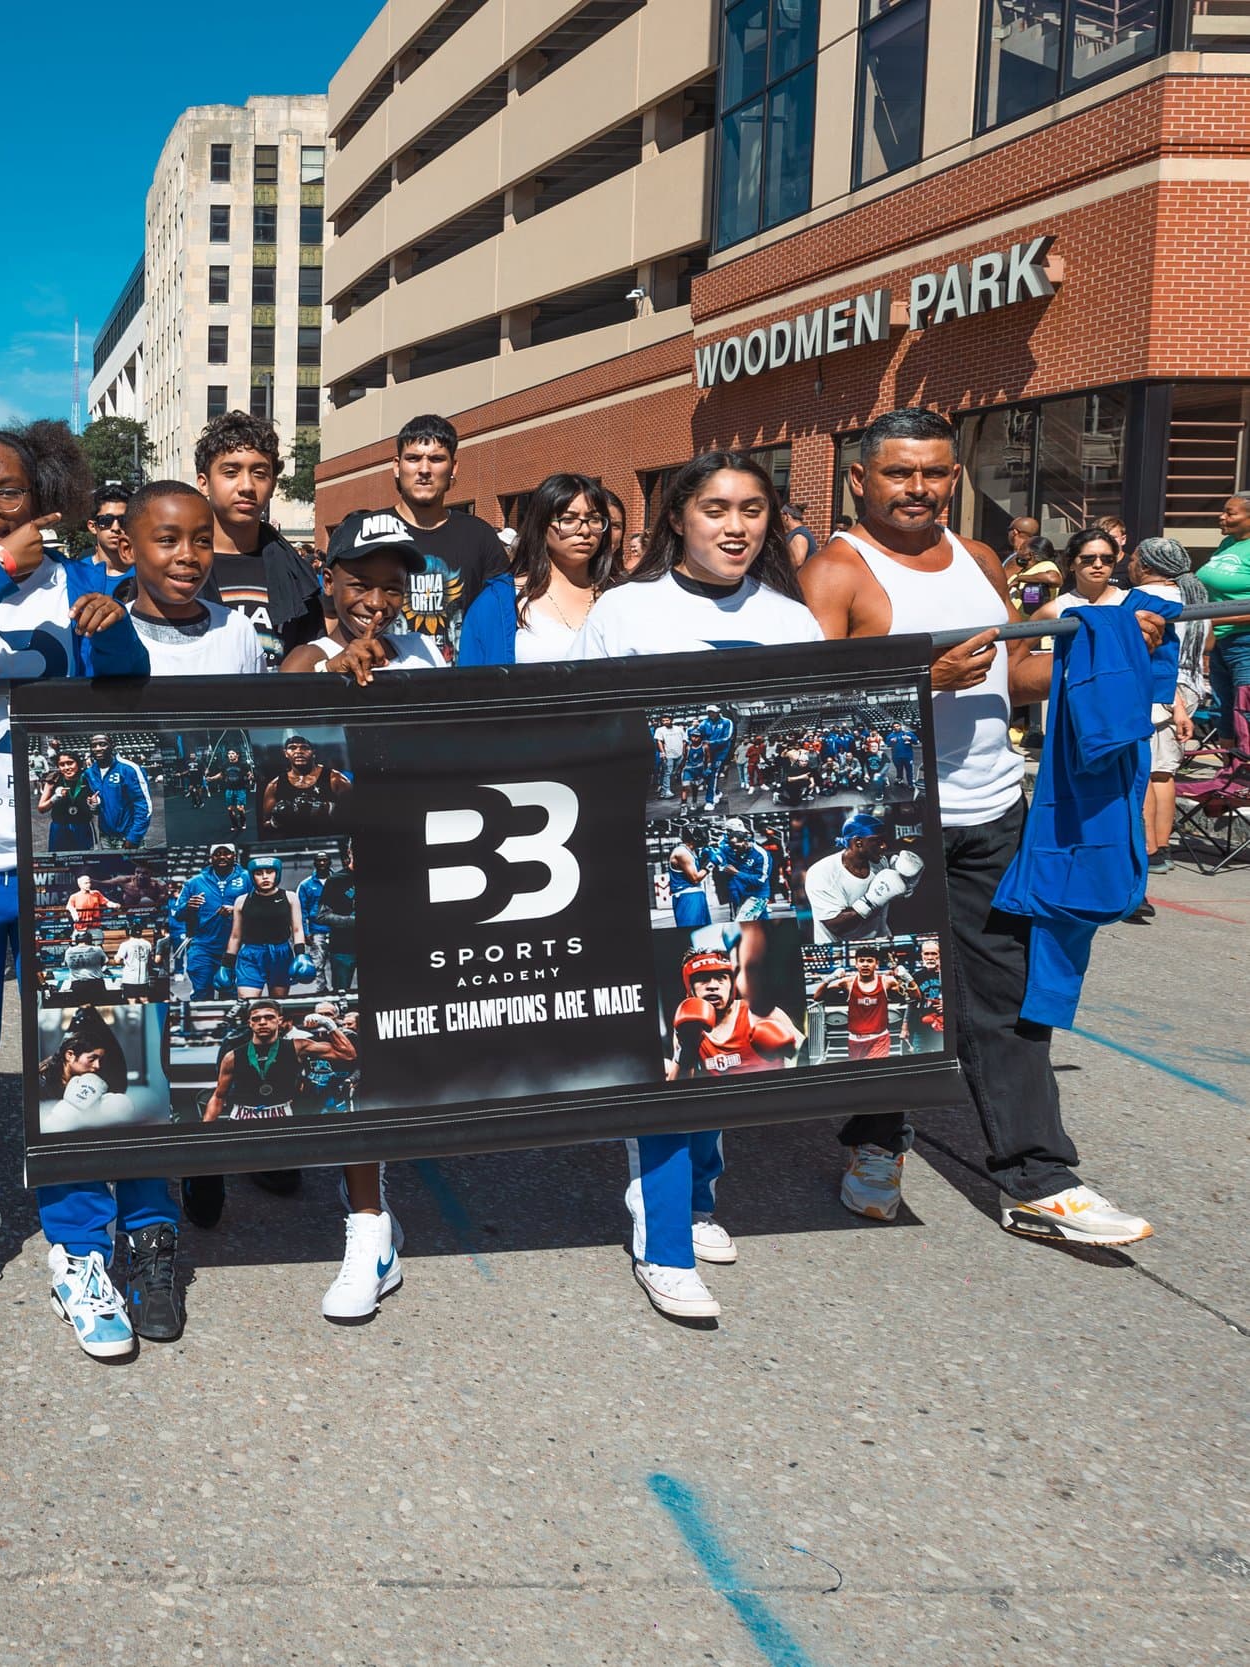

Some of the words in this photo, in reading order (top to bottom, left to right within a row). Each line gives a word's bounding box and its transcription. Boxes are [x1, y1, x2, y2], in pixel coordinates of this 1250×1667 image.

[695, 288, 892, 389] WOODMEN
[910, 235, 1056, 331] PARK
[362, 514, 408, 538] NIKE
[411, 592, 445, 611] ORTIZ
[429, 937, 584, 969] SPORTS
[456, 967, 560, 988] ACADEMY
[375, 1005, 440, 1040] WHERE
[445, 993, 548, 1032] CHAMPIONS
[554, 989, 589, 1021] ARE
[593, 983, 645, 1017] MADE
[235, 1104, 288, 1120] KRISTIAN
